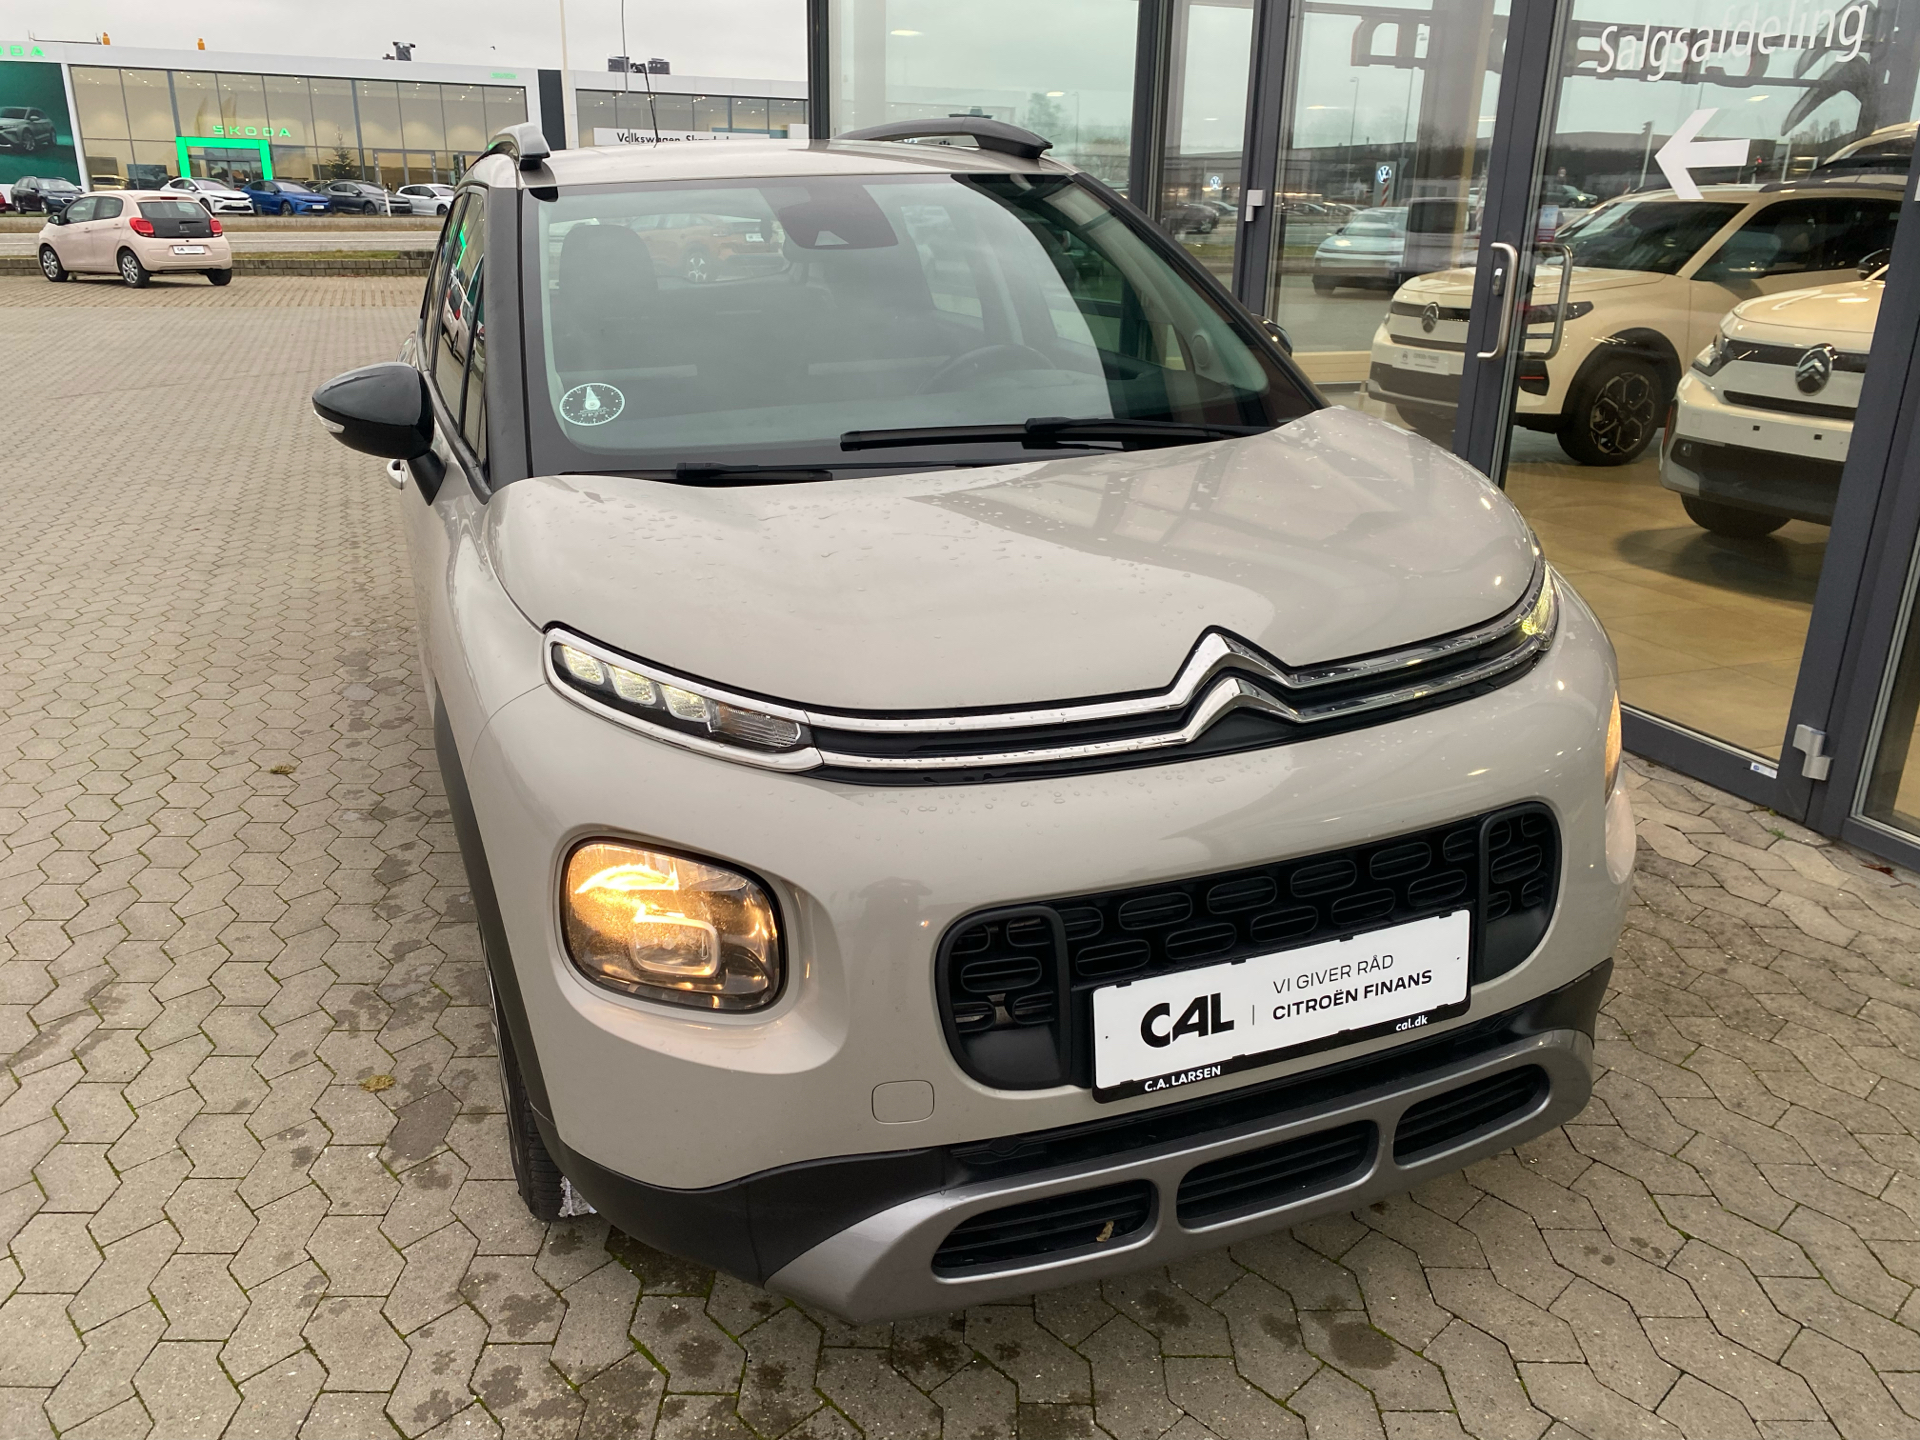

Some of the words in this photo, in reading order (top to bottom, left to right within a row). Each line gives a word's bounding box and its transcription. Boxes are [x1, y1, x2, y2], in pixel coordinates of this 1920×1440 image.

[0, 45, 45, 57] DA
[1596, 0, 1869, 82] Salgsafdeling
[1273, 978, 1291, 994] VI
[1296, 964, 1352, 989] GIVER
[1357, 954, 1394, 976] RÅD
[1272, 988, 1358, 1020] CITROËN
[1364, 969, 1433, 999] FINANS
[1140, 992, 1235, 1048] CAL
[1395, 1014, 1428, 1032] cal.dk
[1144, 1078, 1170, 1092] C.A.
[1171, 1065, 1221, 1086] LARSEN
